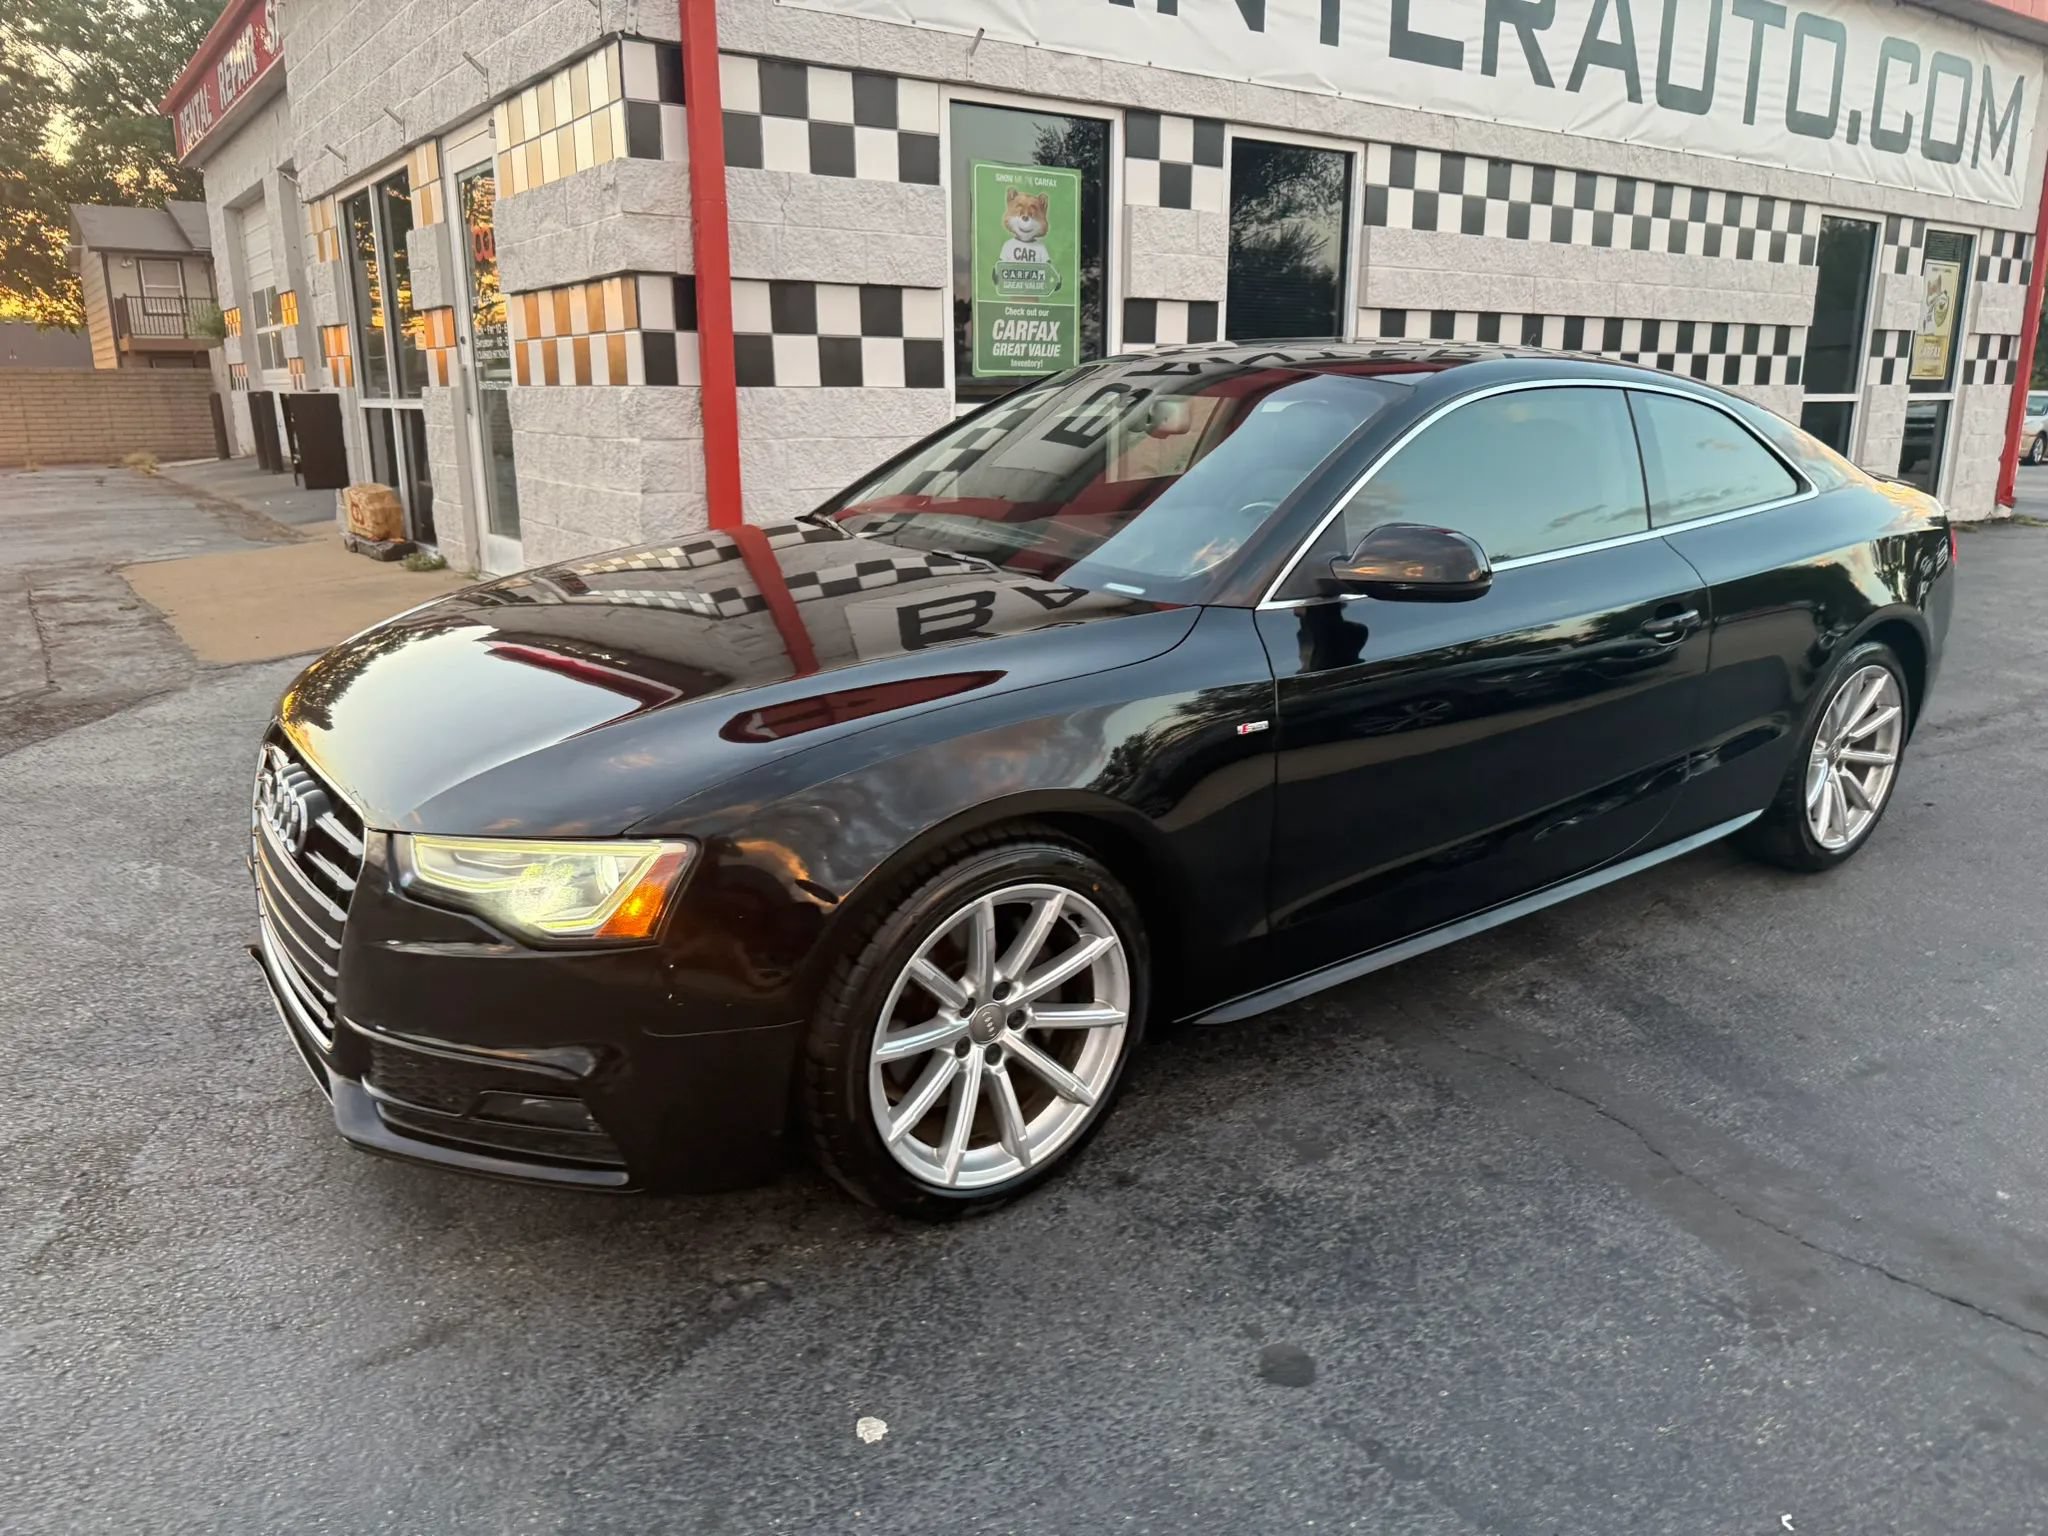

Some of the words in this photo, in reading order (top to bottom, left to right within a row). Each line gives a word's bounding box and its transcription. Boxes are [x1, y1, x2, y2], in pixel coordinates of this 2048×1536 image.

[217, 23, 258, 110] REPAIR
[1013, 247, 1036, 262] CAR
[1001, 269, 1046, 281] CARFAX
[1004, 306, 1025, 317] Check
[1026, 307, 1038, 317] out
[1038, 308, 1050, 317] our
[992, 318, 1061, 342] CARFAX
[992, 342, 1028, 356] GREAT
[1028, 343, 1061, 357] VALUE
[1010, 358, 1044, 369] Inventory!
